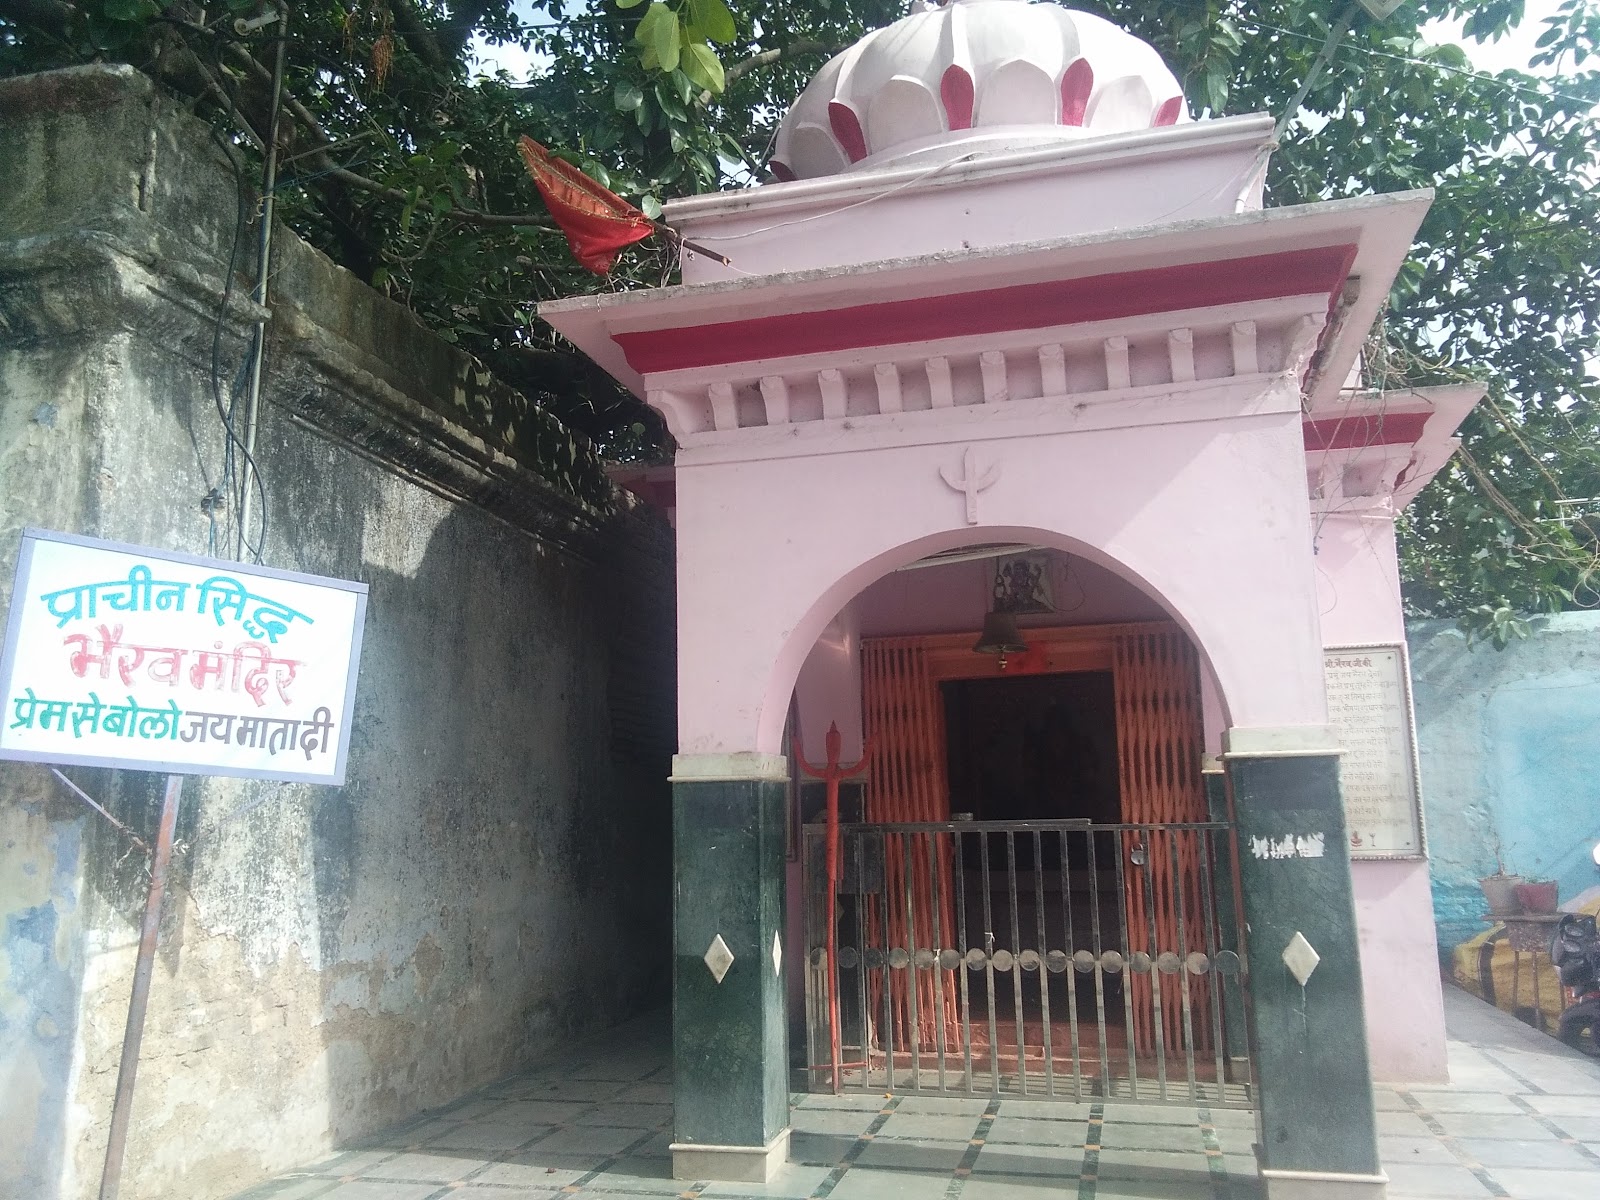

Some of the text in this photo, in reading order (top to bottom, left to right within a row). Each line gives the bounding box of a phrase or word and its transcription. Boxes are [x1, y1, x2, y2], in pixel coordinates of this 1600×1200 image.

[40, 564, 191, 629] प्राचीन
[63, 624, 307, 707] भैरव मंदिर
[10, 687, 335, 761] प्रेम से बोलो जय माता दी
